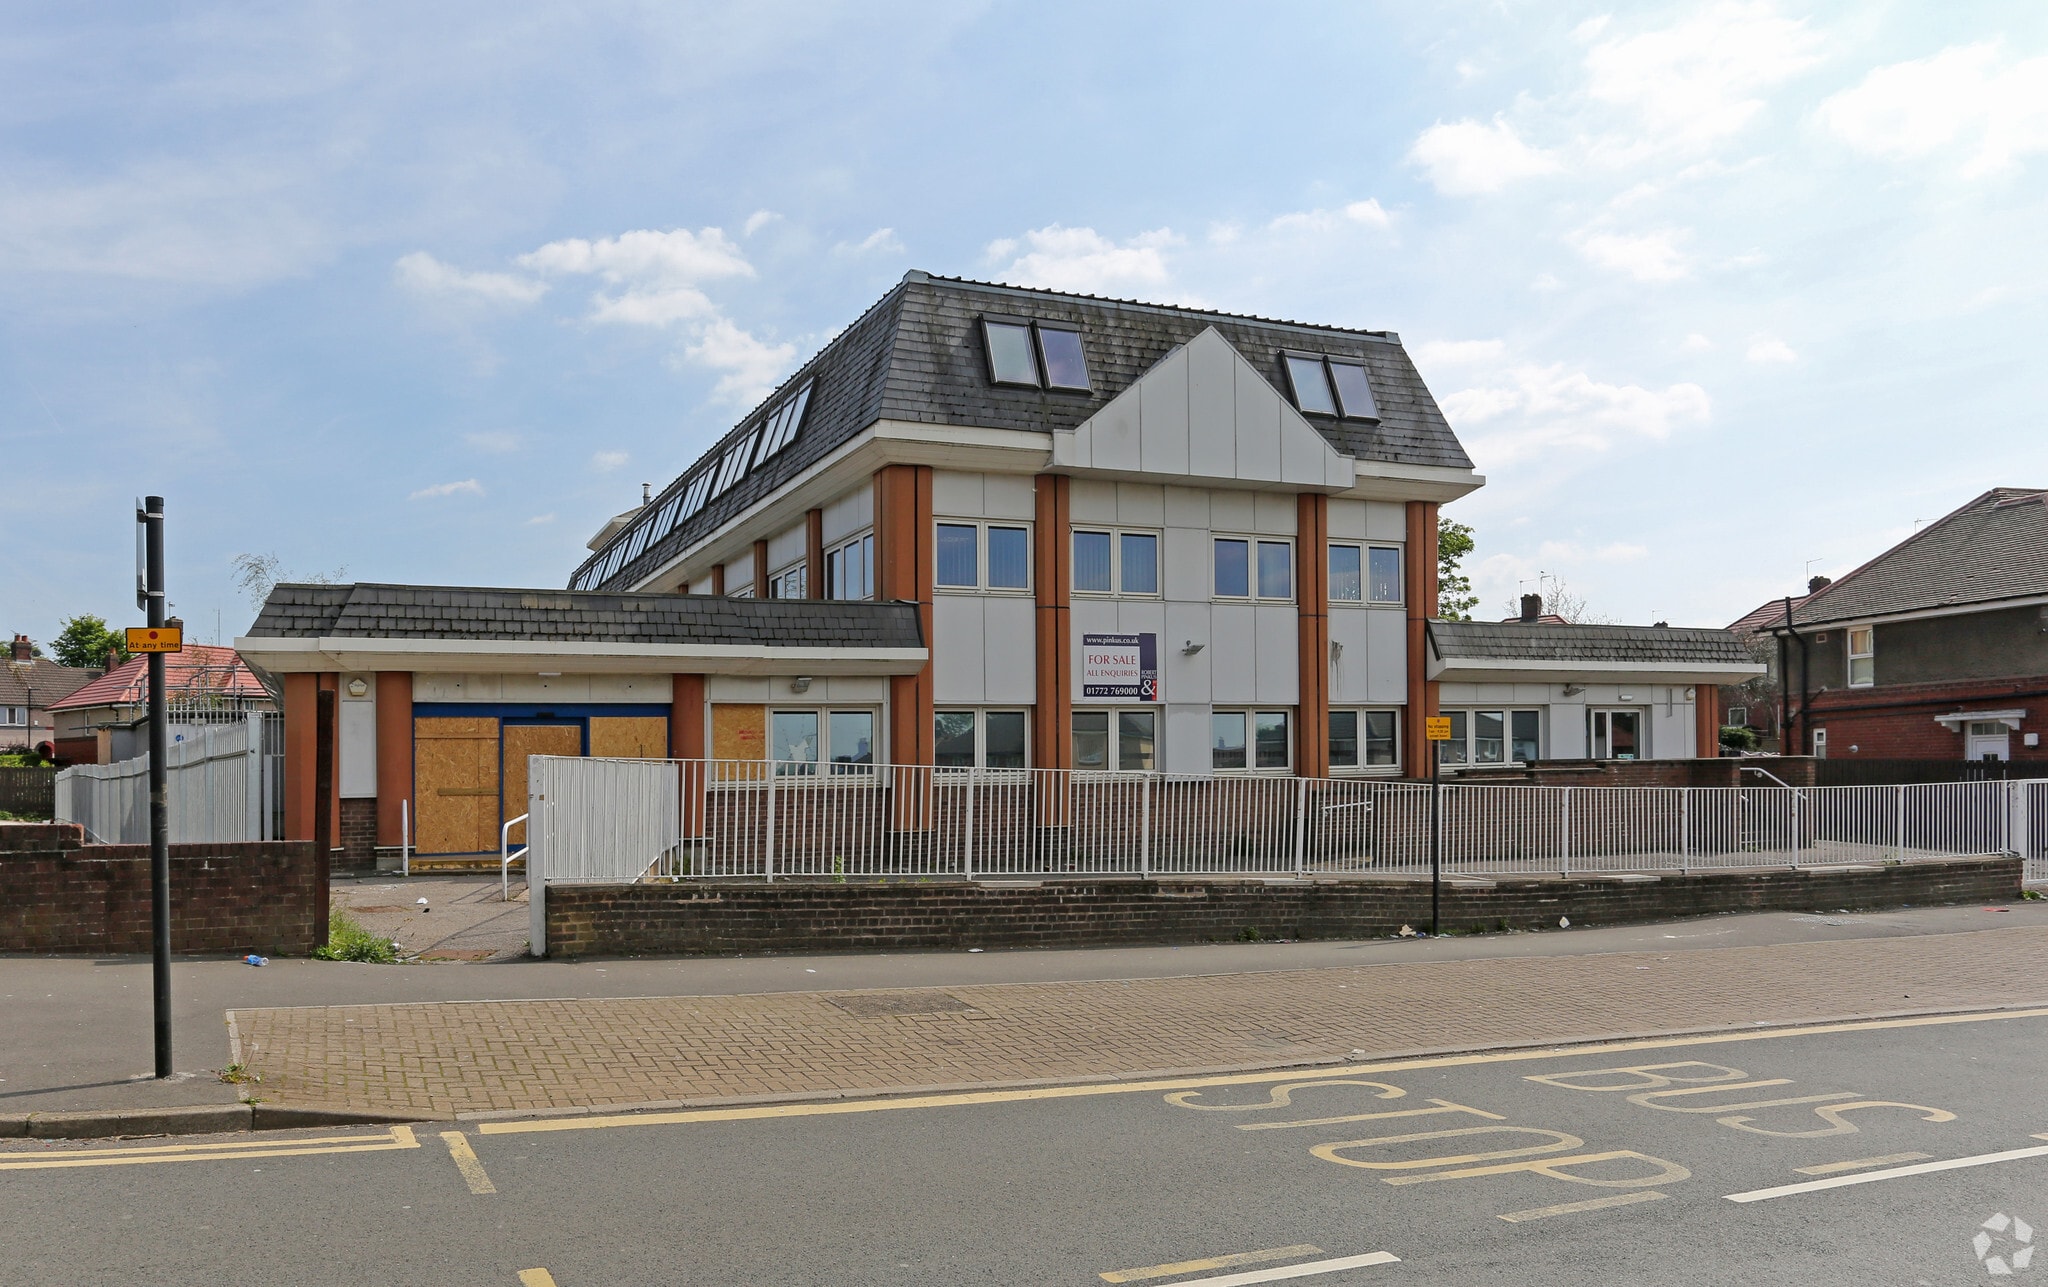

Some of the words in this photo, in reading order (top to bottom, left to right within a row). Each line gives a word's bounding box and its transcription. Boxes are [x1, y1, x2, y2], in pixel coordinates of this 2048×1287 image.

[1086, 636, 1139, 645] www.pinkus.co.uk
[1088, 655, 1110, 665] FOR
[1112, 655, 1136, 665] SALE
[1100, 669, 1138, 678] ENQUIRIES
[1086, 687, 1109, 695] 01772
[1110, 687, 1138, 695] 769000
[1140, 679, 1156, 696] &
[1522, 1060, 1958, 1139] BUS
[1163, 1079, 1692, 1188] STOP
